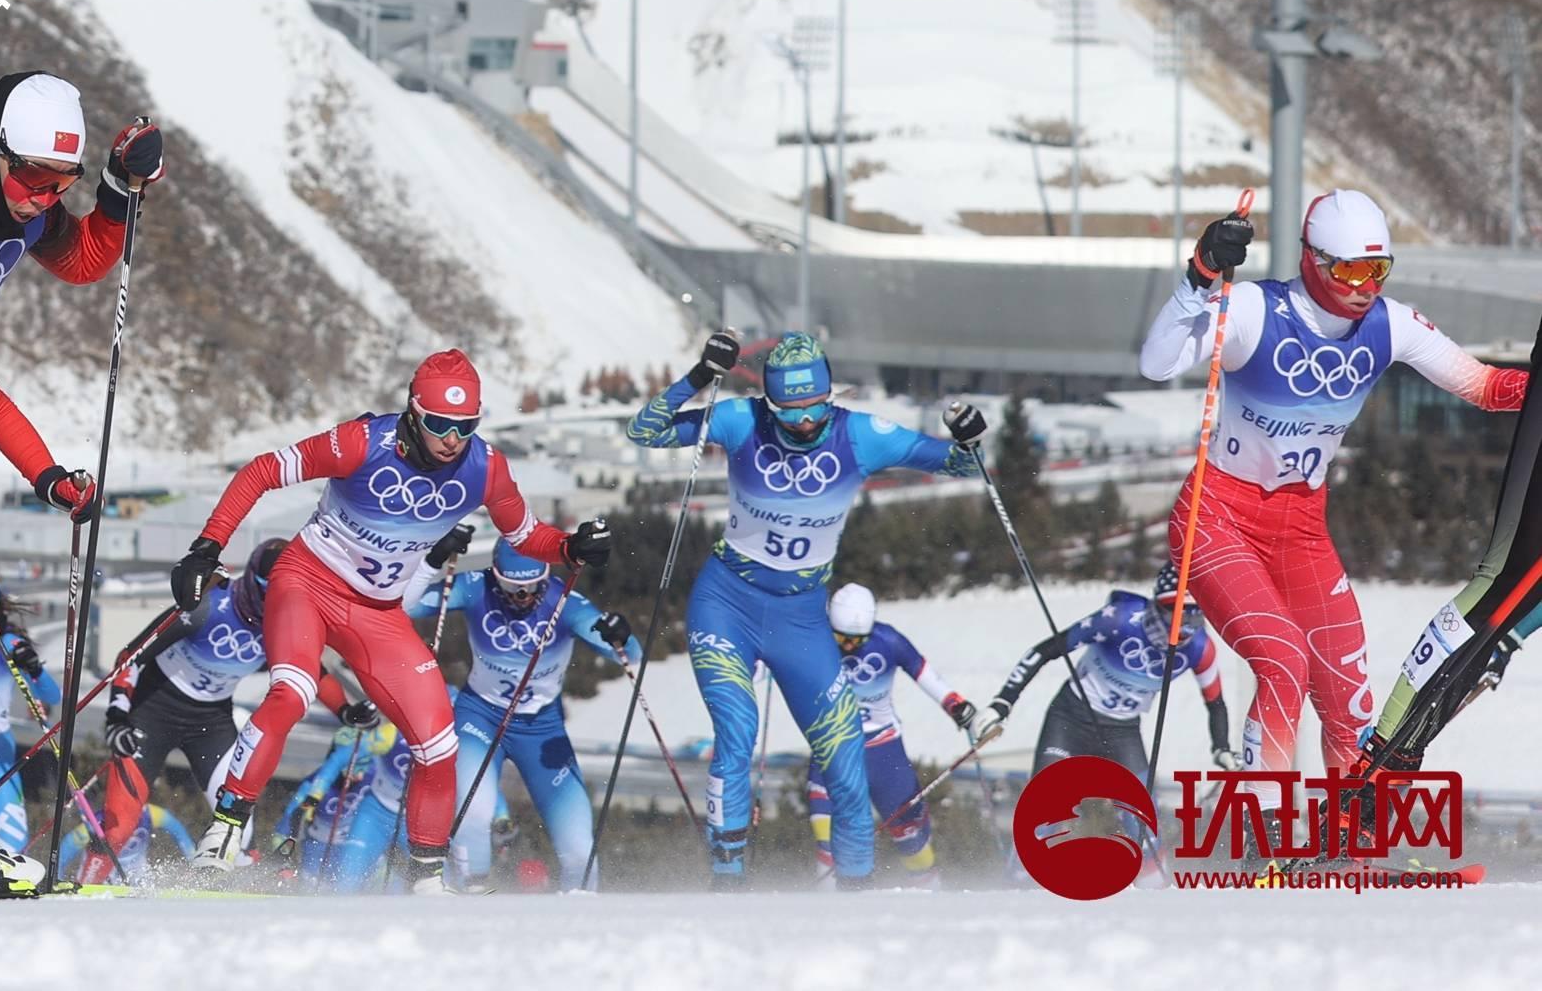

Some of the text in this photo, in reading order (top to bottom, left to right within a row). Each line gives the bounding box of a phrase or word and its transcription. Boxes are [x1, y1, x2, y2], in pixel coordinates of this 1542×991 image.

[784, 384, 816, 397] KAZ
[1242, 404, 1348, 438] BEIJING 20
[1277, 446, 1322, 481] 30
[338, 508, 437, 553] BEIJING 202
[799, 512, 845, 528] 2022
[764, 529, 811, 560] 50
[356, 556, 405, 589] 23
[690, 630, 736, 653] KAZ
[1007, 647, 1043, 690] US
[1101, 690, 1139, 710] 39
[233, 745, 245, 762] 3
[1243, 748, 1254, 765] 0
